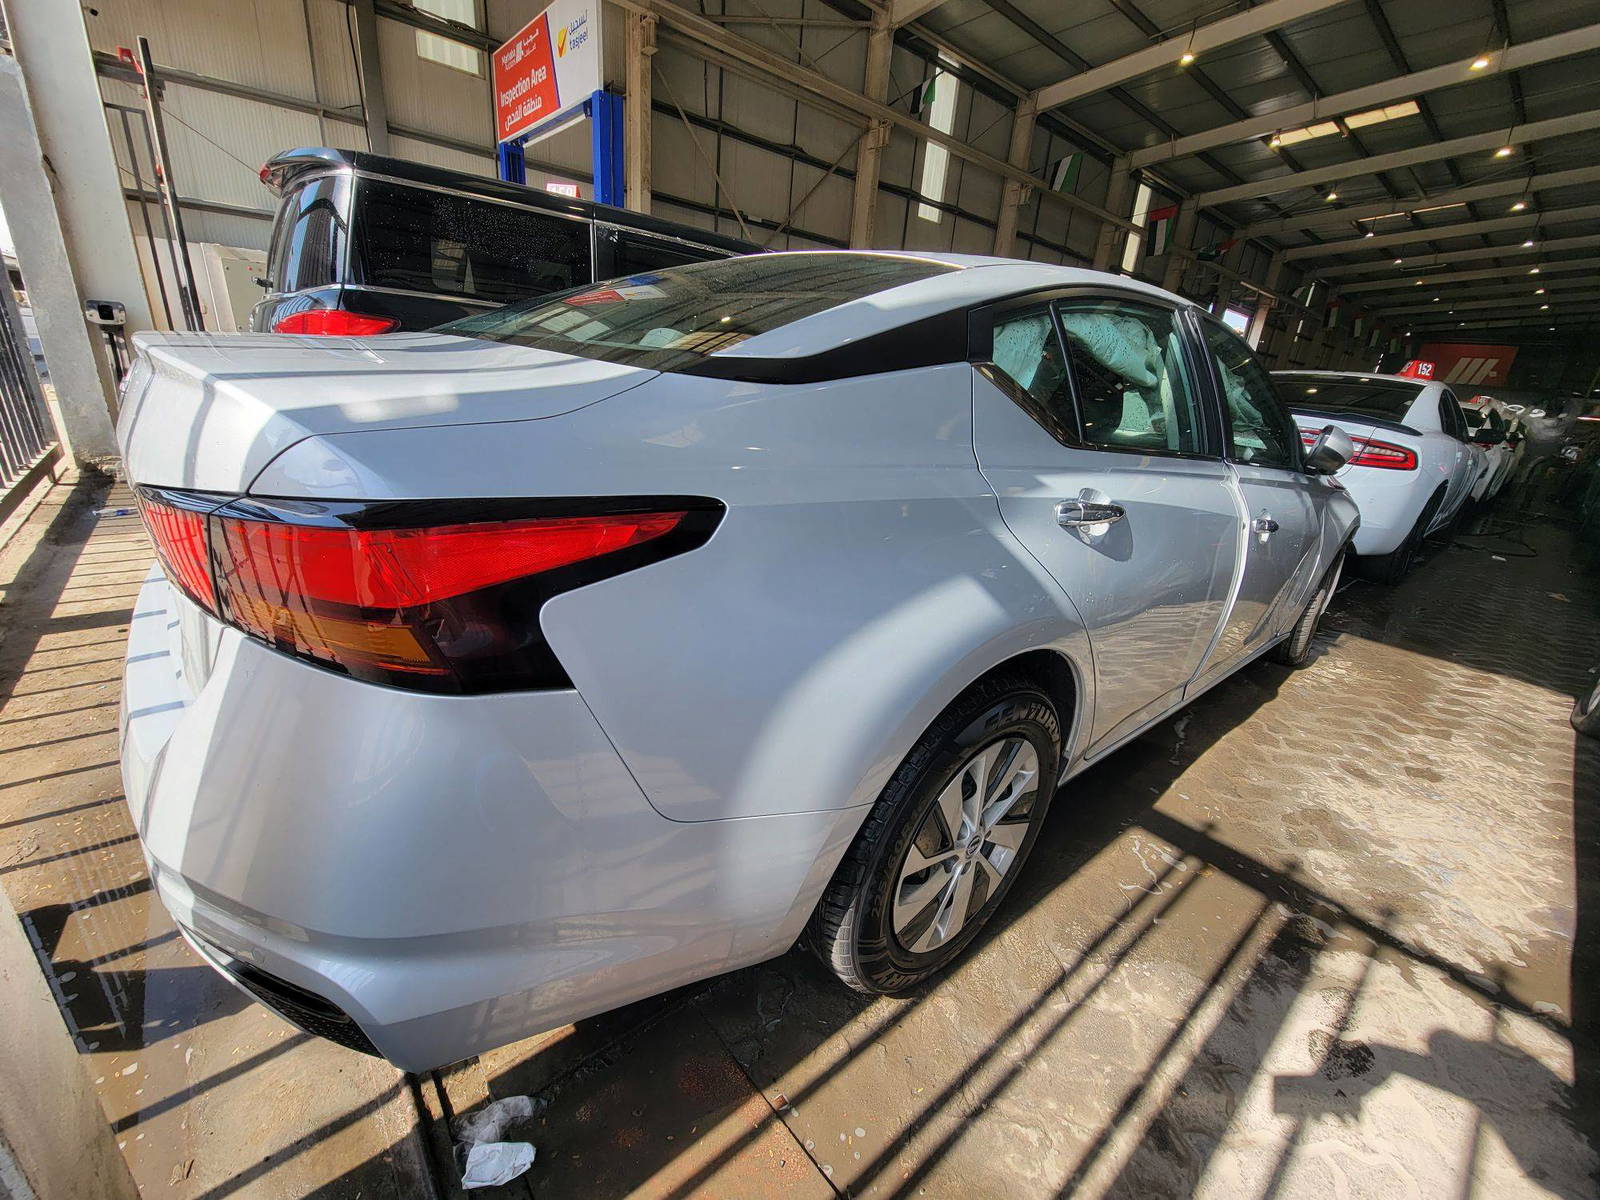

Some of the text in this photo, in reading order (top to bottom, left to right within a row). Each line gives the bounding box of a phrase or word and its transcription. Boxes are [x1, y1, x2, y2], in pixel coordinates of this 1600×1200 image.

[569, 26, 588, 50] tasjeel
[501, 65, 547, 107] Inspection Area
[1417, 362, 1432, 376] 152
